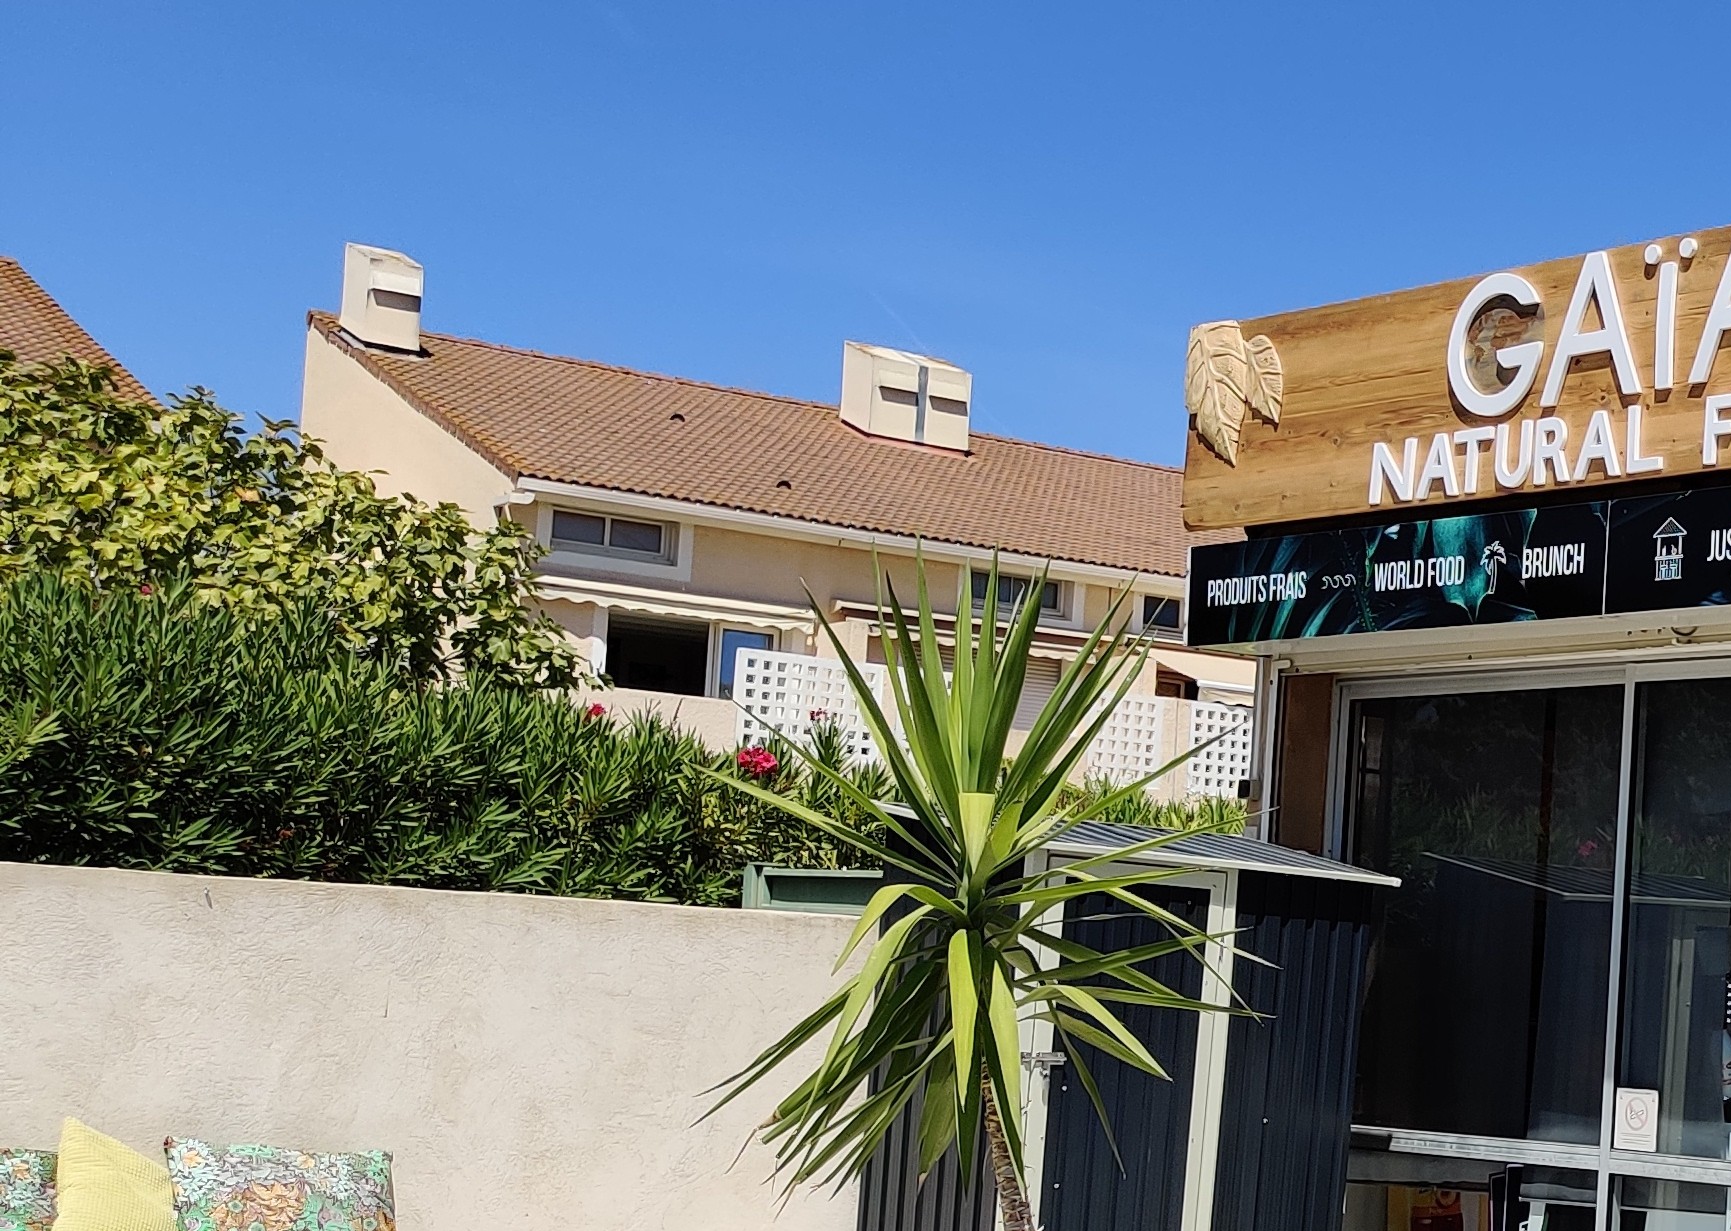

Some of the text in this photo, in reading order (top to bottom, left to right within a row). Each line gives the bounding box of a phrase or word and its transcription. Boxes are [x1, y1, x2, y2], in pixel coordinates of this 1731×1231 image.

[1368, 405, 1664, 506] NATURAL
[1374, 555, 1465, 592] WORLD FOOD
[1522, 542, 1585, 580] BRUNCH
[1207, 570, 1307, 607] PRODUITS FRAIS
